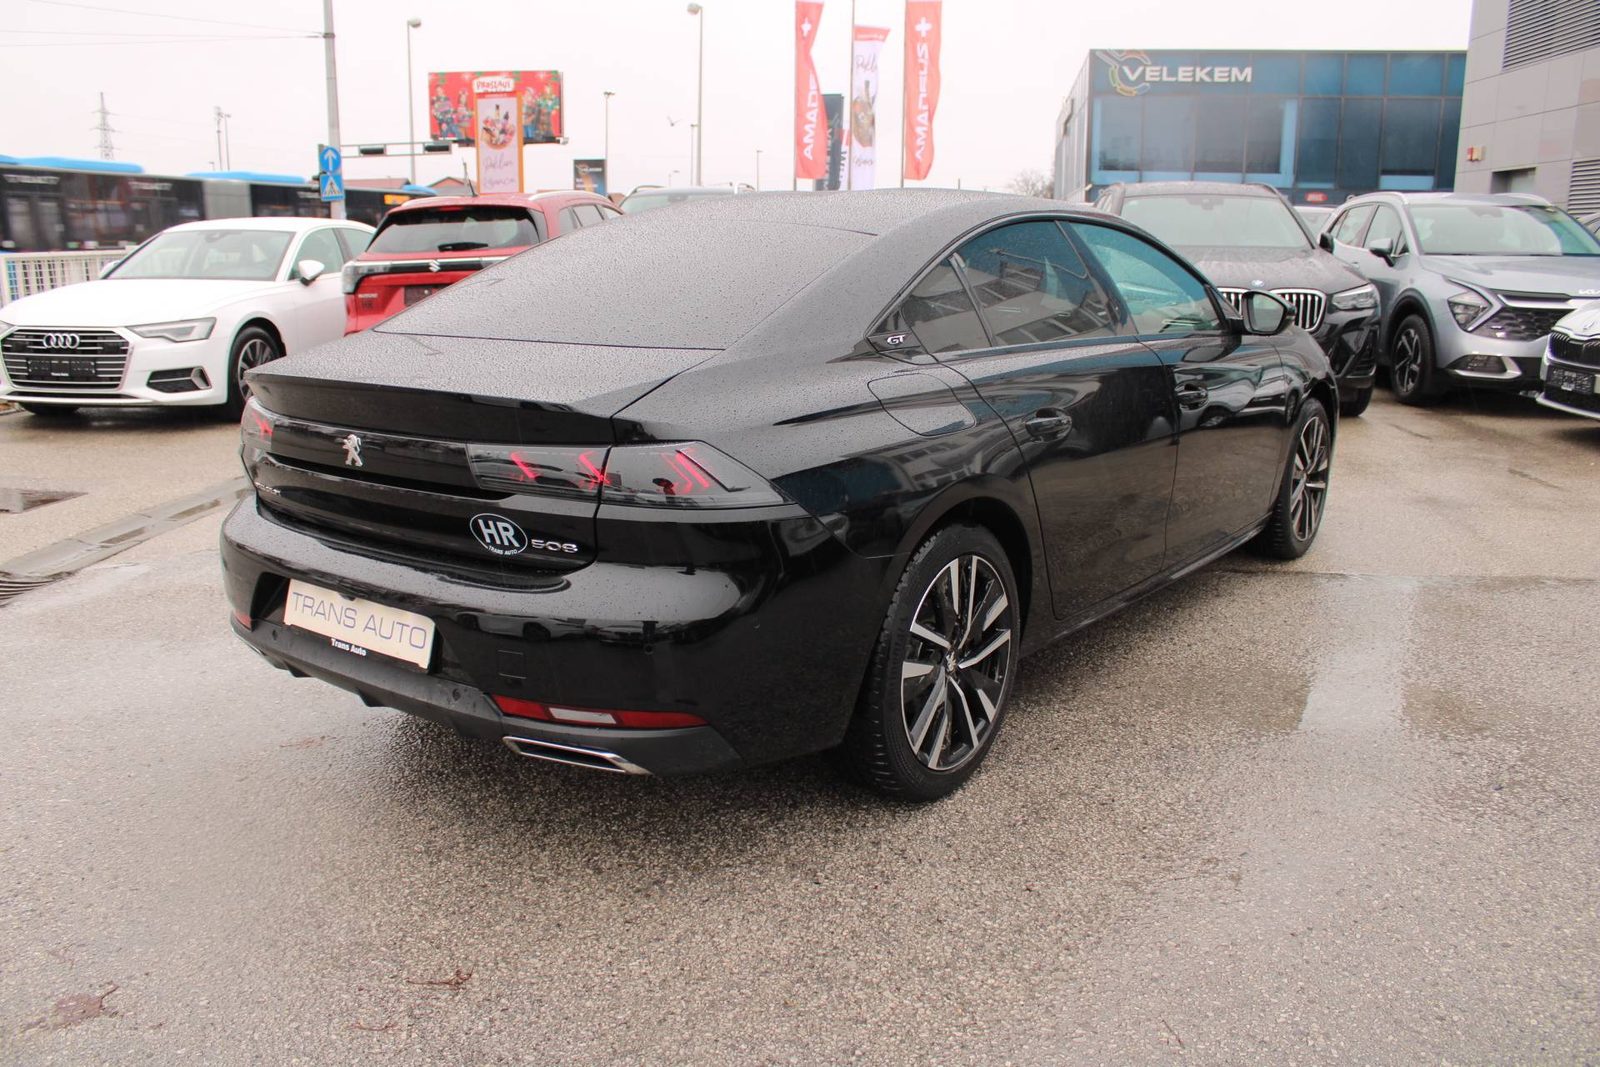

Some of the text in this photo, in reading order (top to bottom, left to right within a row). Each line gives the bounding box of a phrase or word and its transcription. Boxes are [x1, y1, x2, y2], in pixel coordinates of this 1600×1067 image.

[1122, 65, 1253, 83] VELEKEM
[886, 334, 906, 345] GT
[477, 518, 521, 548] HR
[487, 545, 503, 556] TRANS
[531, 539, 579, 553] 508
[292, 591, 428, 650] TRANS AUTO
[331, 637, 367, 657] Trans Auto
